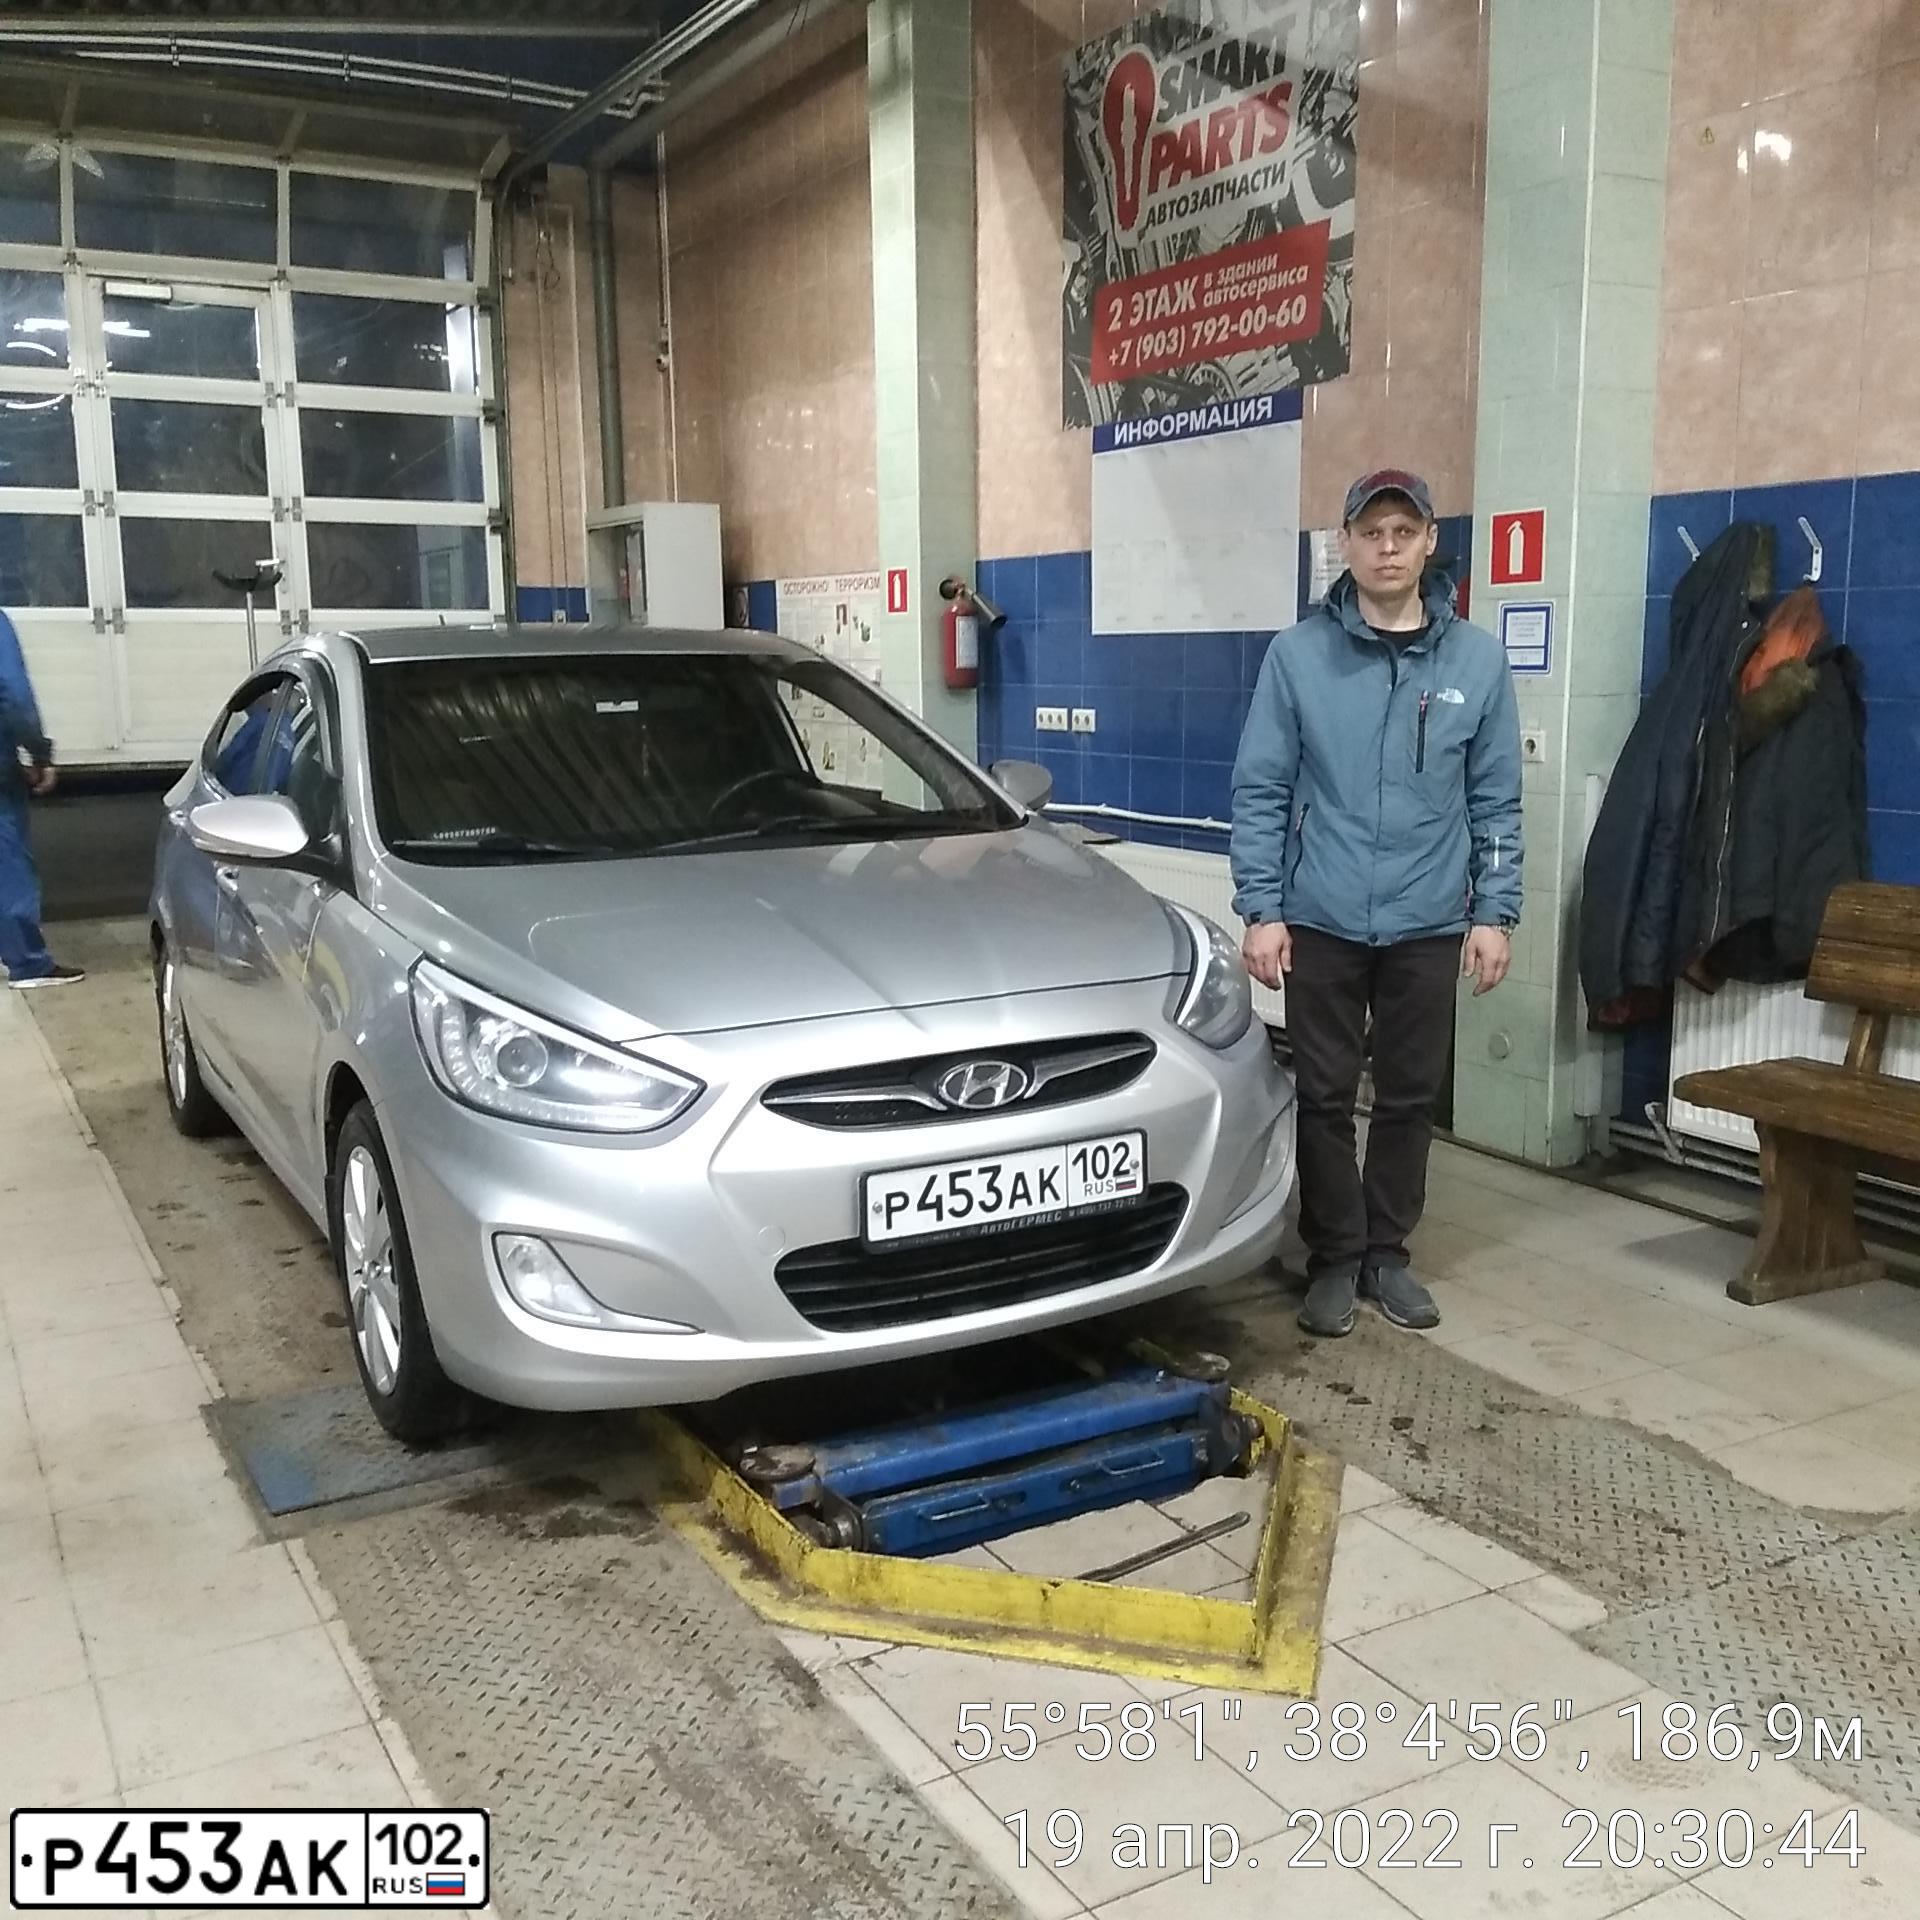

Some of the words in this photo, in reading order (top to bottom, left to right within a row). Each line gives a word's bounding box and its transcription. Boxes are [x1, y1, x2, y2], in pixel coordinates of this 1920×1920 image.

[1148, 80, 1293, 195] PARTS
[1145, 159, 1287, 229] АВТОЗАПЧАСТИ
[1203, 264, 1309, 308] автосервиса
[1204, 271, 1214, 289] в
[1217, 253, 1279, 286] здании
[1108, 297, 1123, 332] 2
[1129, 275, 1199, 328] ЭТАЖ
[1108, 338, 1132, 367] +7
[1136, 325, 1186, 368] (903)
[1191, 294, 1308, 349] 792-00-60
[1114, 395, 1273, 446] ИНФОРМАЦИЯ
[835, 575, 880, 592] ТЕРРОРИЗМ
[885, 1164, 1061, 1230] Р453АК
[1072, 1141, 1130, 1184] 102
[1084, 1180, 1114, 1197] RUS
